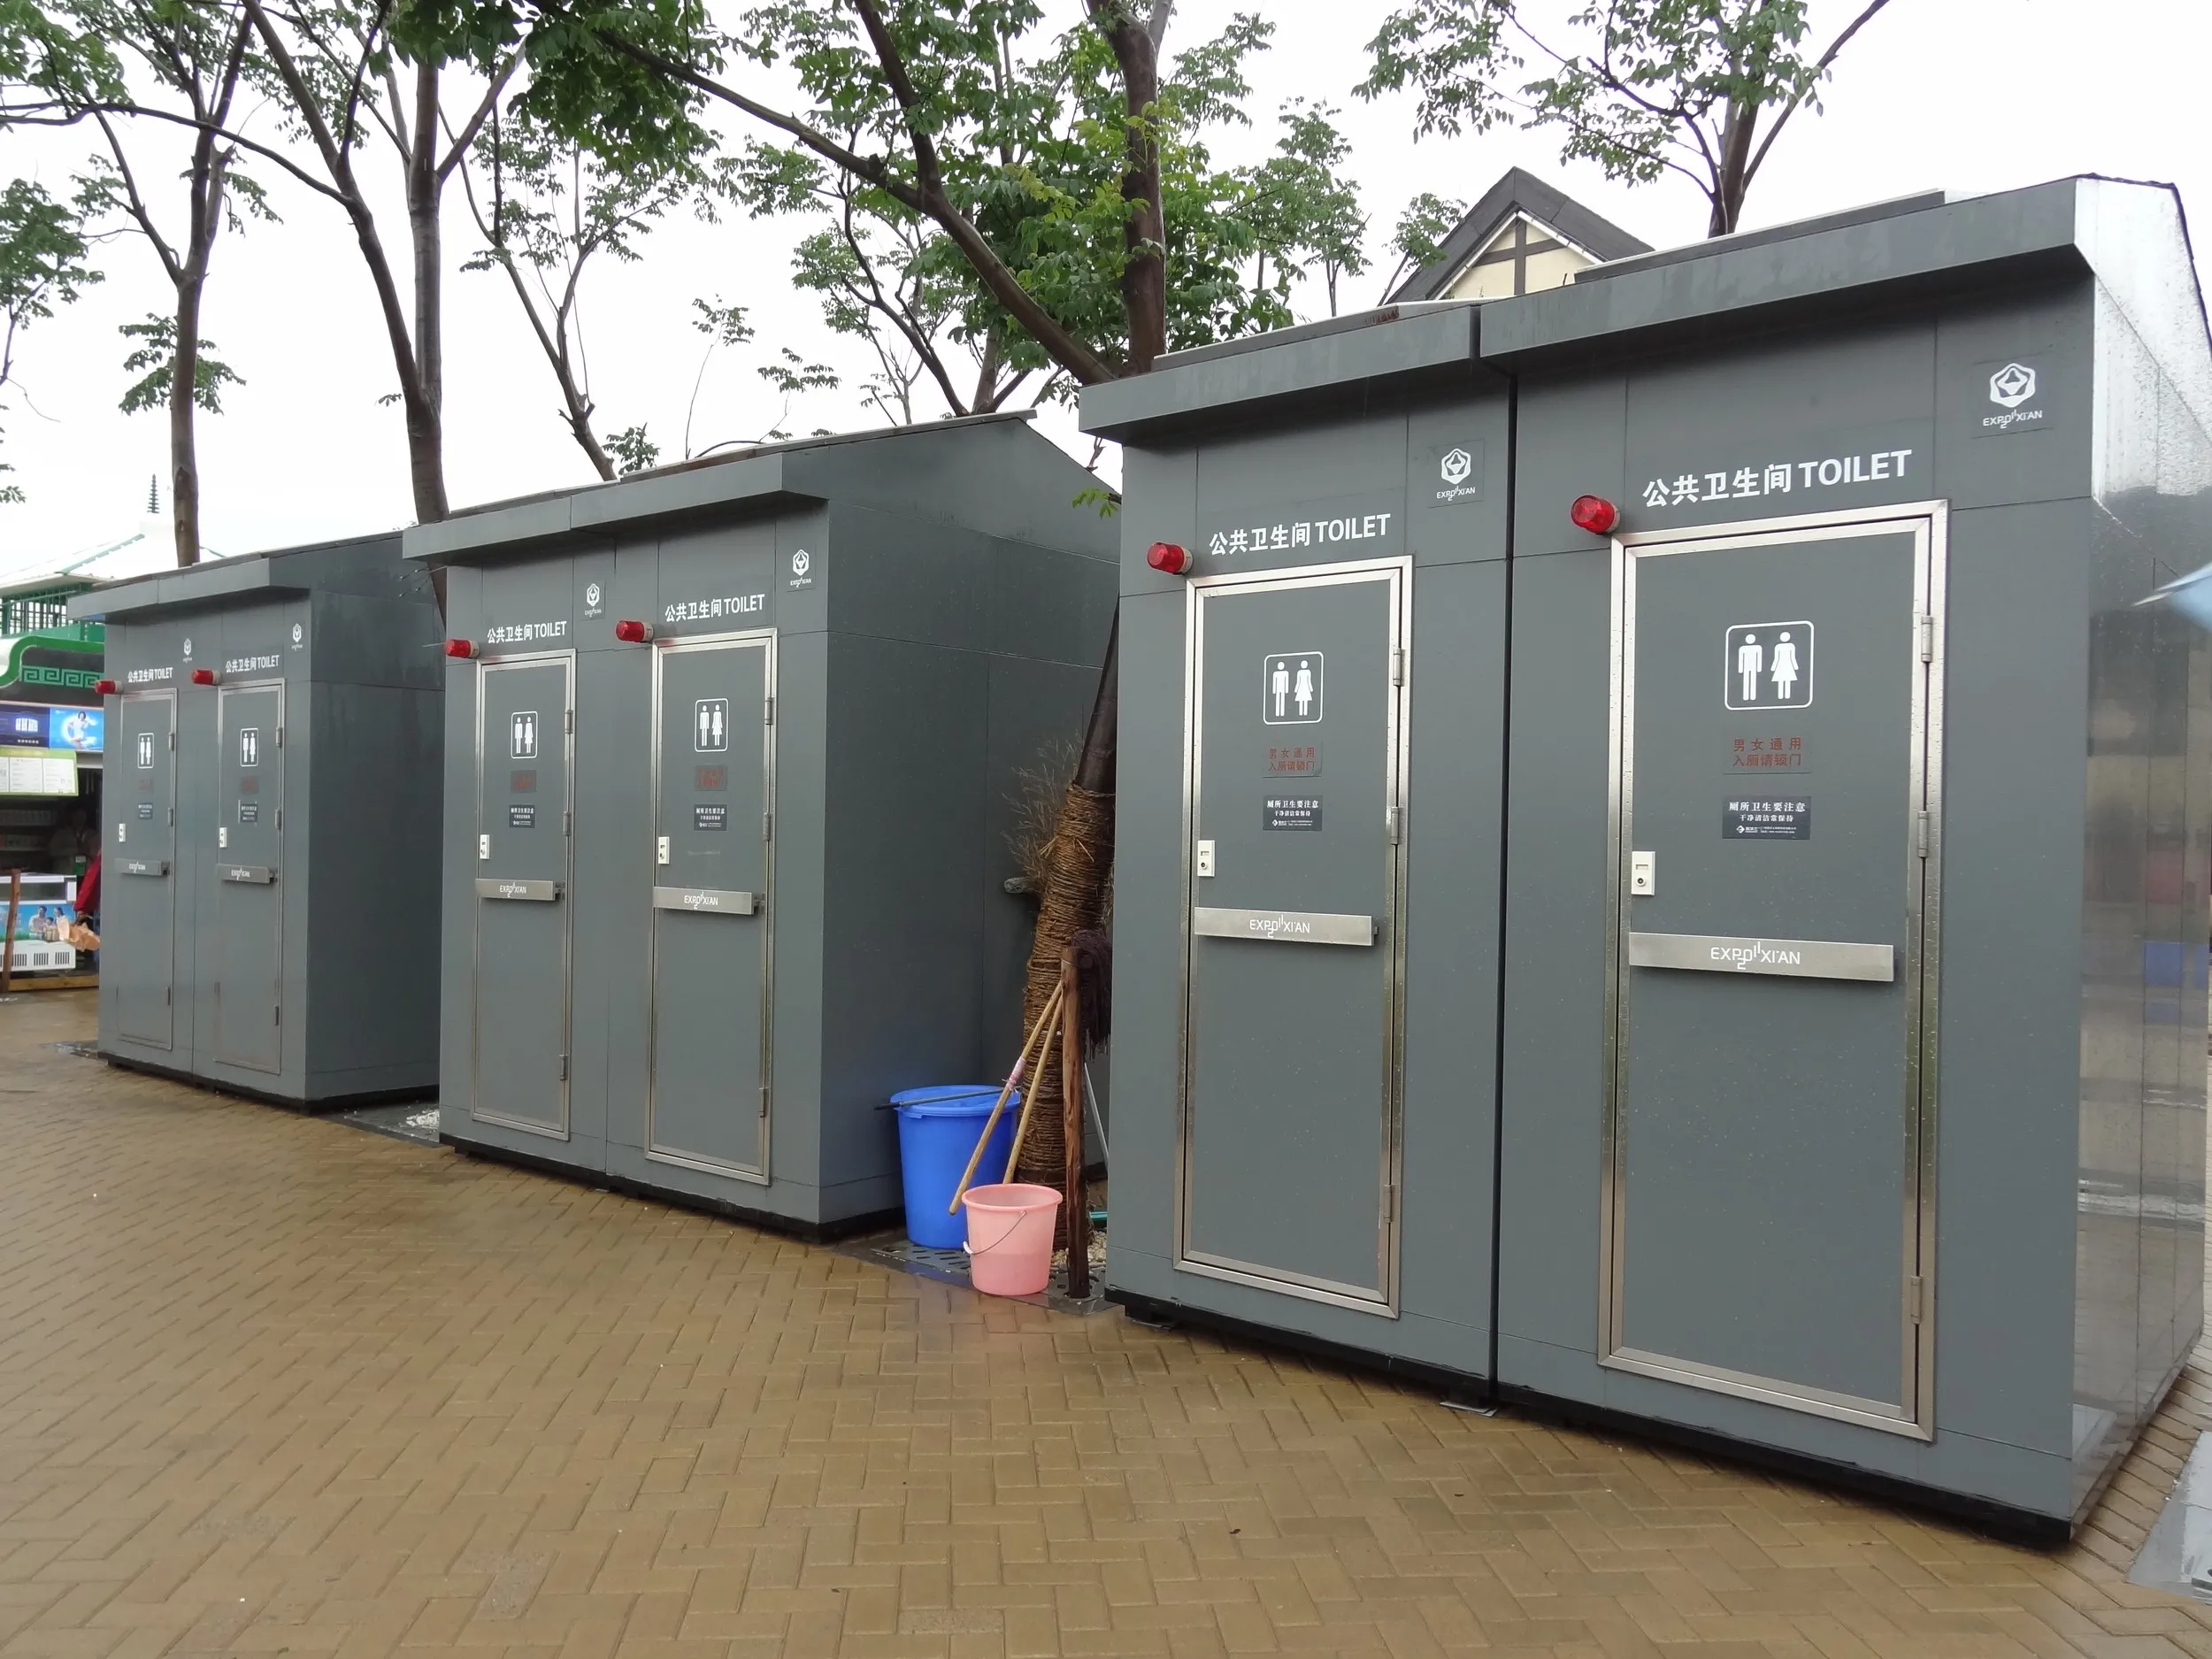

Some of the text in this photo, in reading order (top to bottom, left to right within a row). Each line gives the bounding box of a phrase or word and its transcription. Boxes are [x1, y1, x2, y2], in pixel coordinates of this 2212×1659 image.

[1642, 449, 1913, 508] 公共卫生间 TOILET
[1209, 513, 1391, 556] 公共卫生间 TOILET
[664, 594, 765, 623] 公共卫生间 TOILET
[487, 621, 567, 644] 公共卫生间 TOILET
[154, 667, 173, 680] TOILET
[257, 655, 280, 670] TOILET
[1732, 737, 1802, 751] 男女通用
